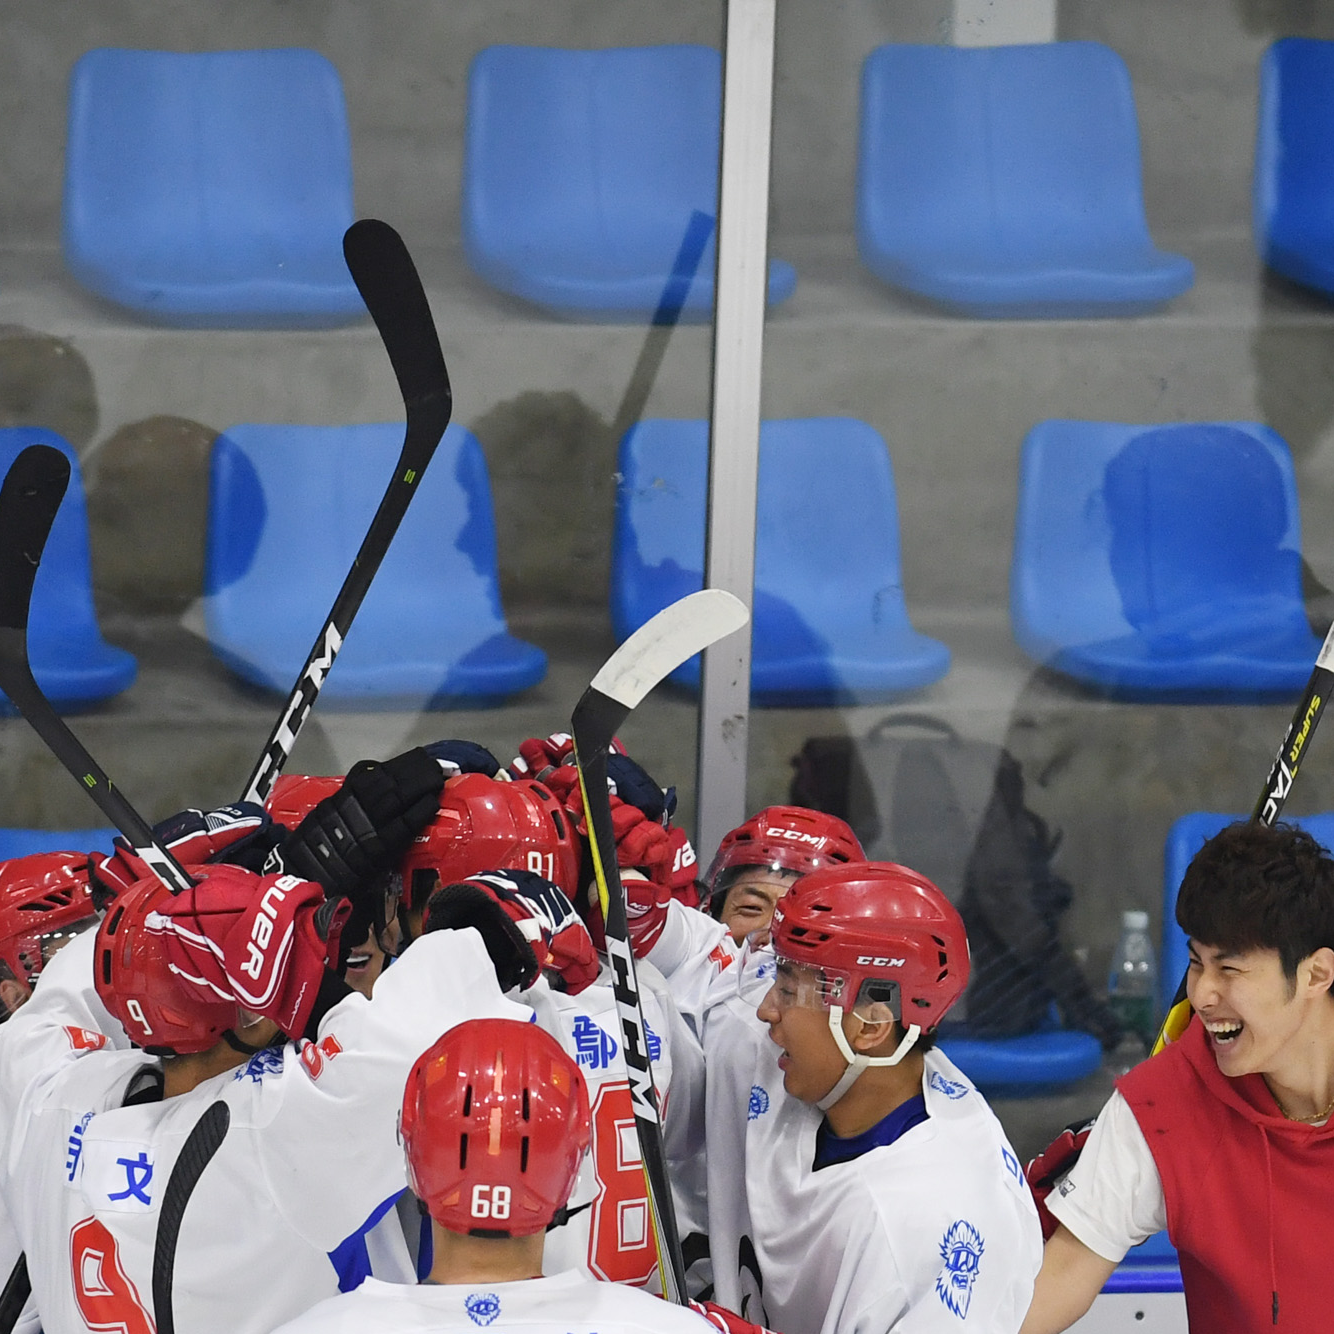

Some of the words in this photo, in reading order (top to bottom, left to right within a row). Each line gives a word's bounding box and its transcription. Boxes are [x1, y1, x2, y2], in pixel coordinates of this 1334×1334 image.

[246, 620, 343, 807] CCM
[1289, 694, 1322, 763] SUPER
[1259, 757, 1300, 828] TAC
[414, 835, 431, 844] CM
[767, 827, 828, 850] CCM
[239, 874, 309, 981] AUER
[856, 955, 906, 968] CCM
[125, 998, 154, 1036] 9
[470, 1184, 512, 1220] 68
